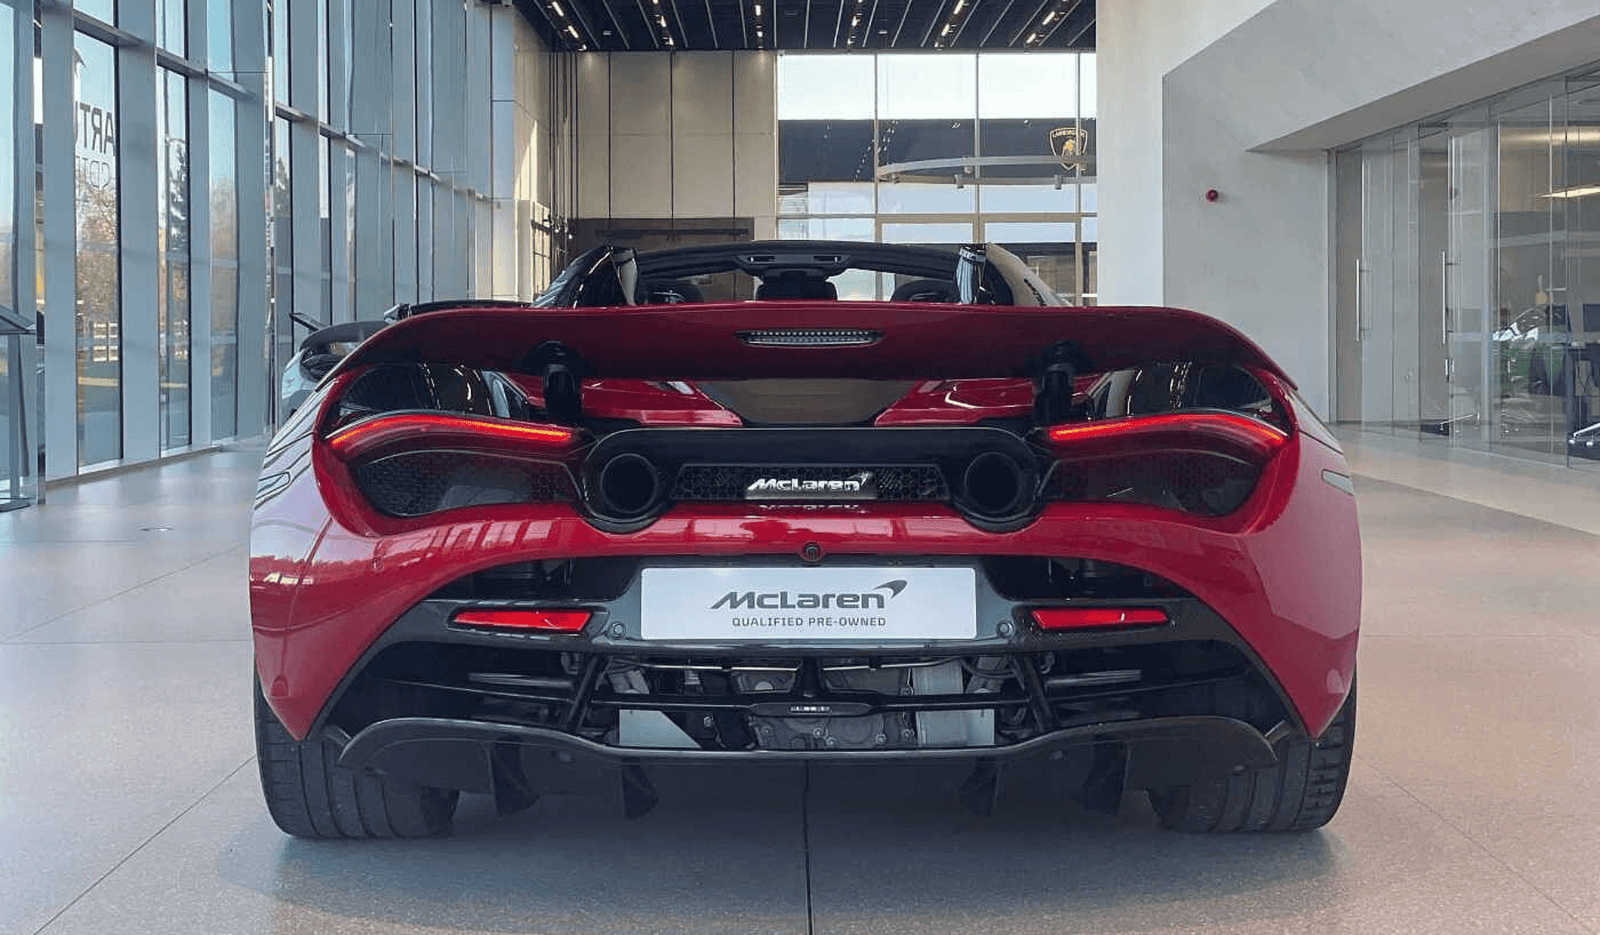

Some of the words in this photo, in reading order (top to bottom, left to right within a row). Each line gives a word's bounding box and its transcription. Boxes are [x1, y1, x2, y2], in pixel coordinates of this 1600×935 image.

[747, 478, 861, 491] McLaren
[709, 590, 886, 610] McLaren
[731, 616, 804, 627] QUALIFIED
[808, 616, 887, 627] PRE-OWNED
